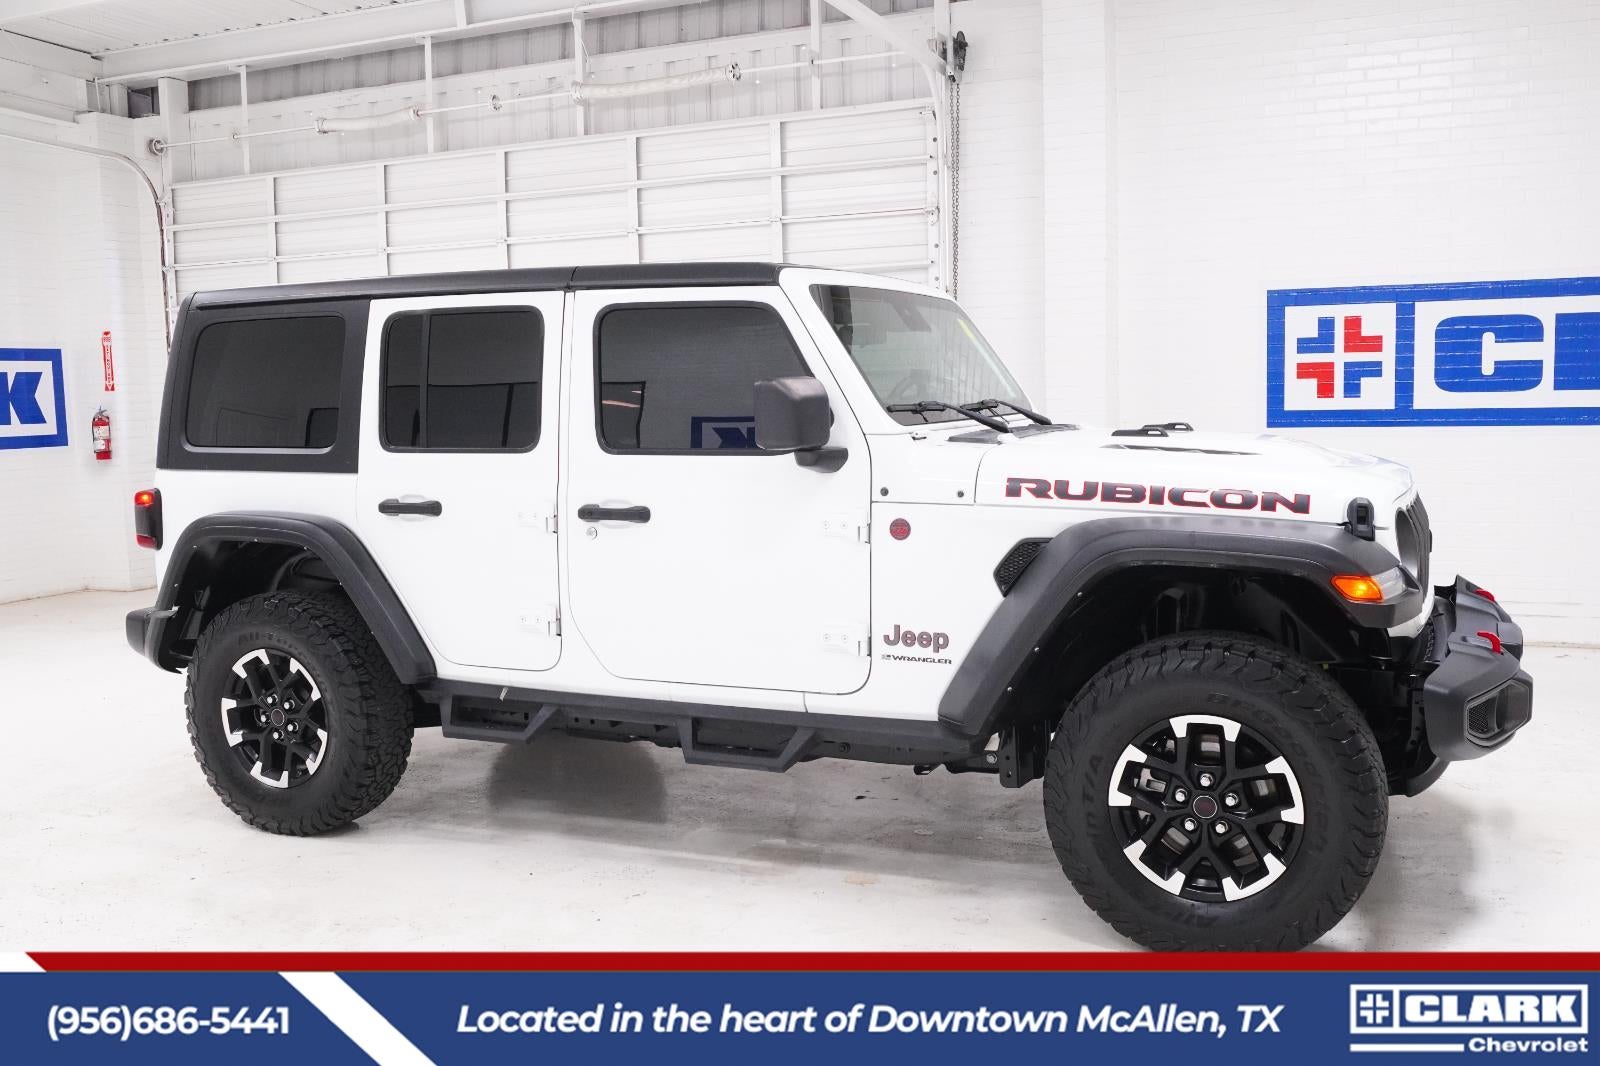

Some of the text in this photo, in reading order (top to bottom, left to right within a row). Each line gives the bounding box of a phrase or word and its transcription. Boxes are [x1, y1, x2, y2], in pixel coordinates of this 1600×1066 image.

[1005, 477, 1311, 514] RUBICON
[883, 624, 949, 653] Jeep
[891, 655, 952, 665] WRANGLER
